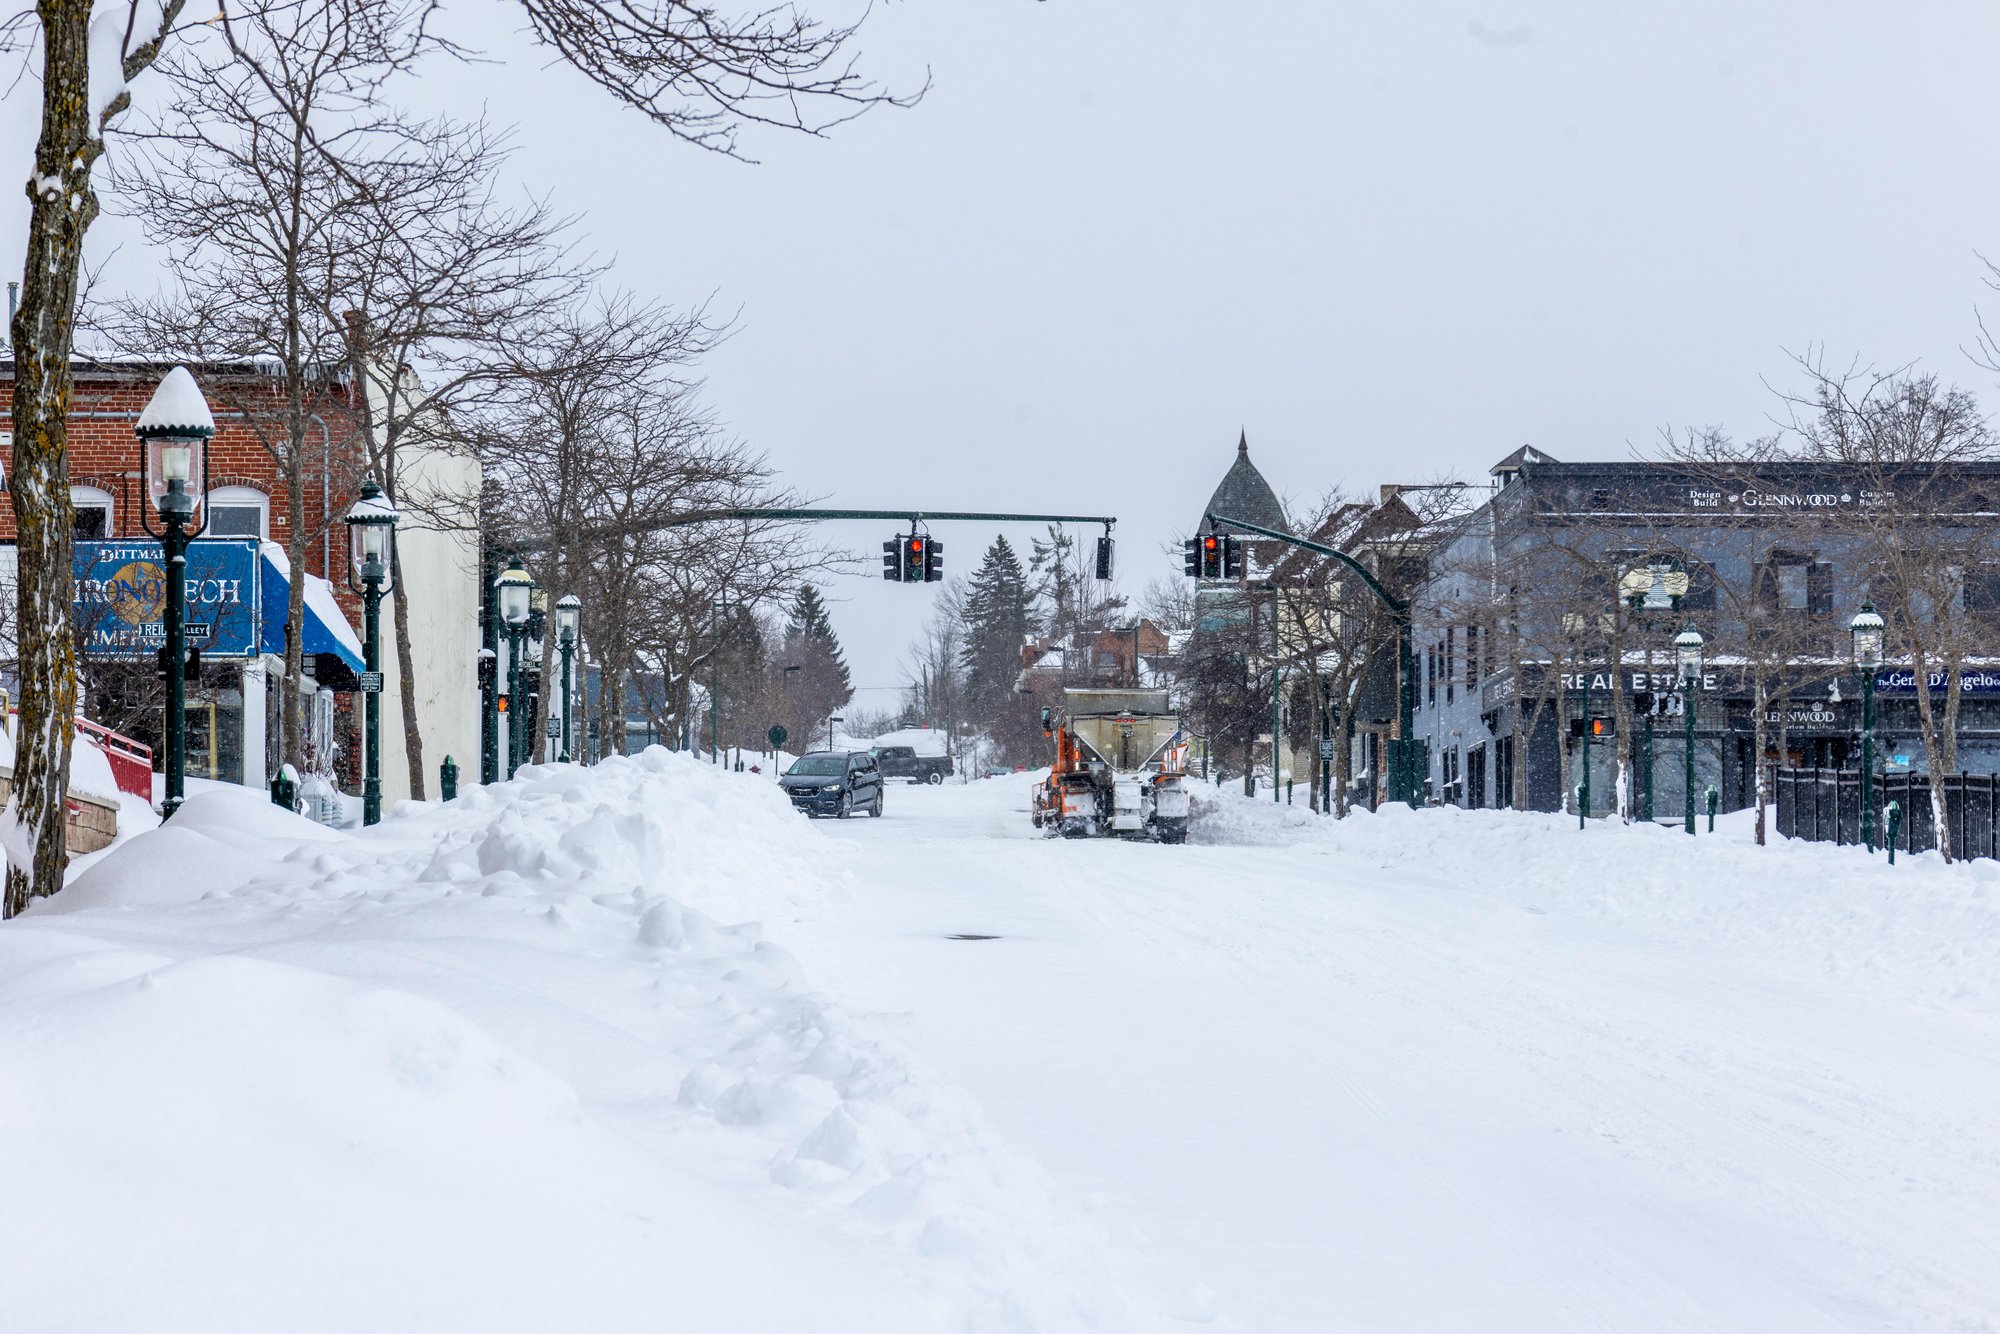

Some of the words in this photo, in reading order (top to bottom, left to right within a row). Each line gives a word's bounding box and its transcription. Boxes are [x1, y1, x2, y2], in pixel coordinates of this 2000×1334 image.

[1690, 490, 1720, 498] Design
[73, 579, 241, 603] RONOECH
[1632, 673, 1717, 690] ESTAE
